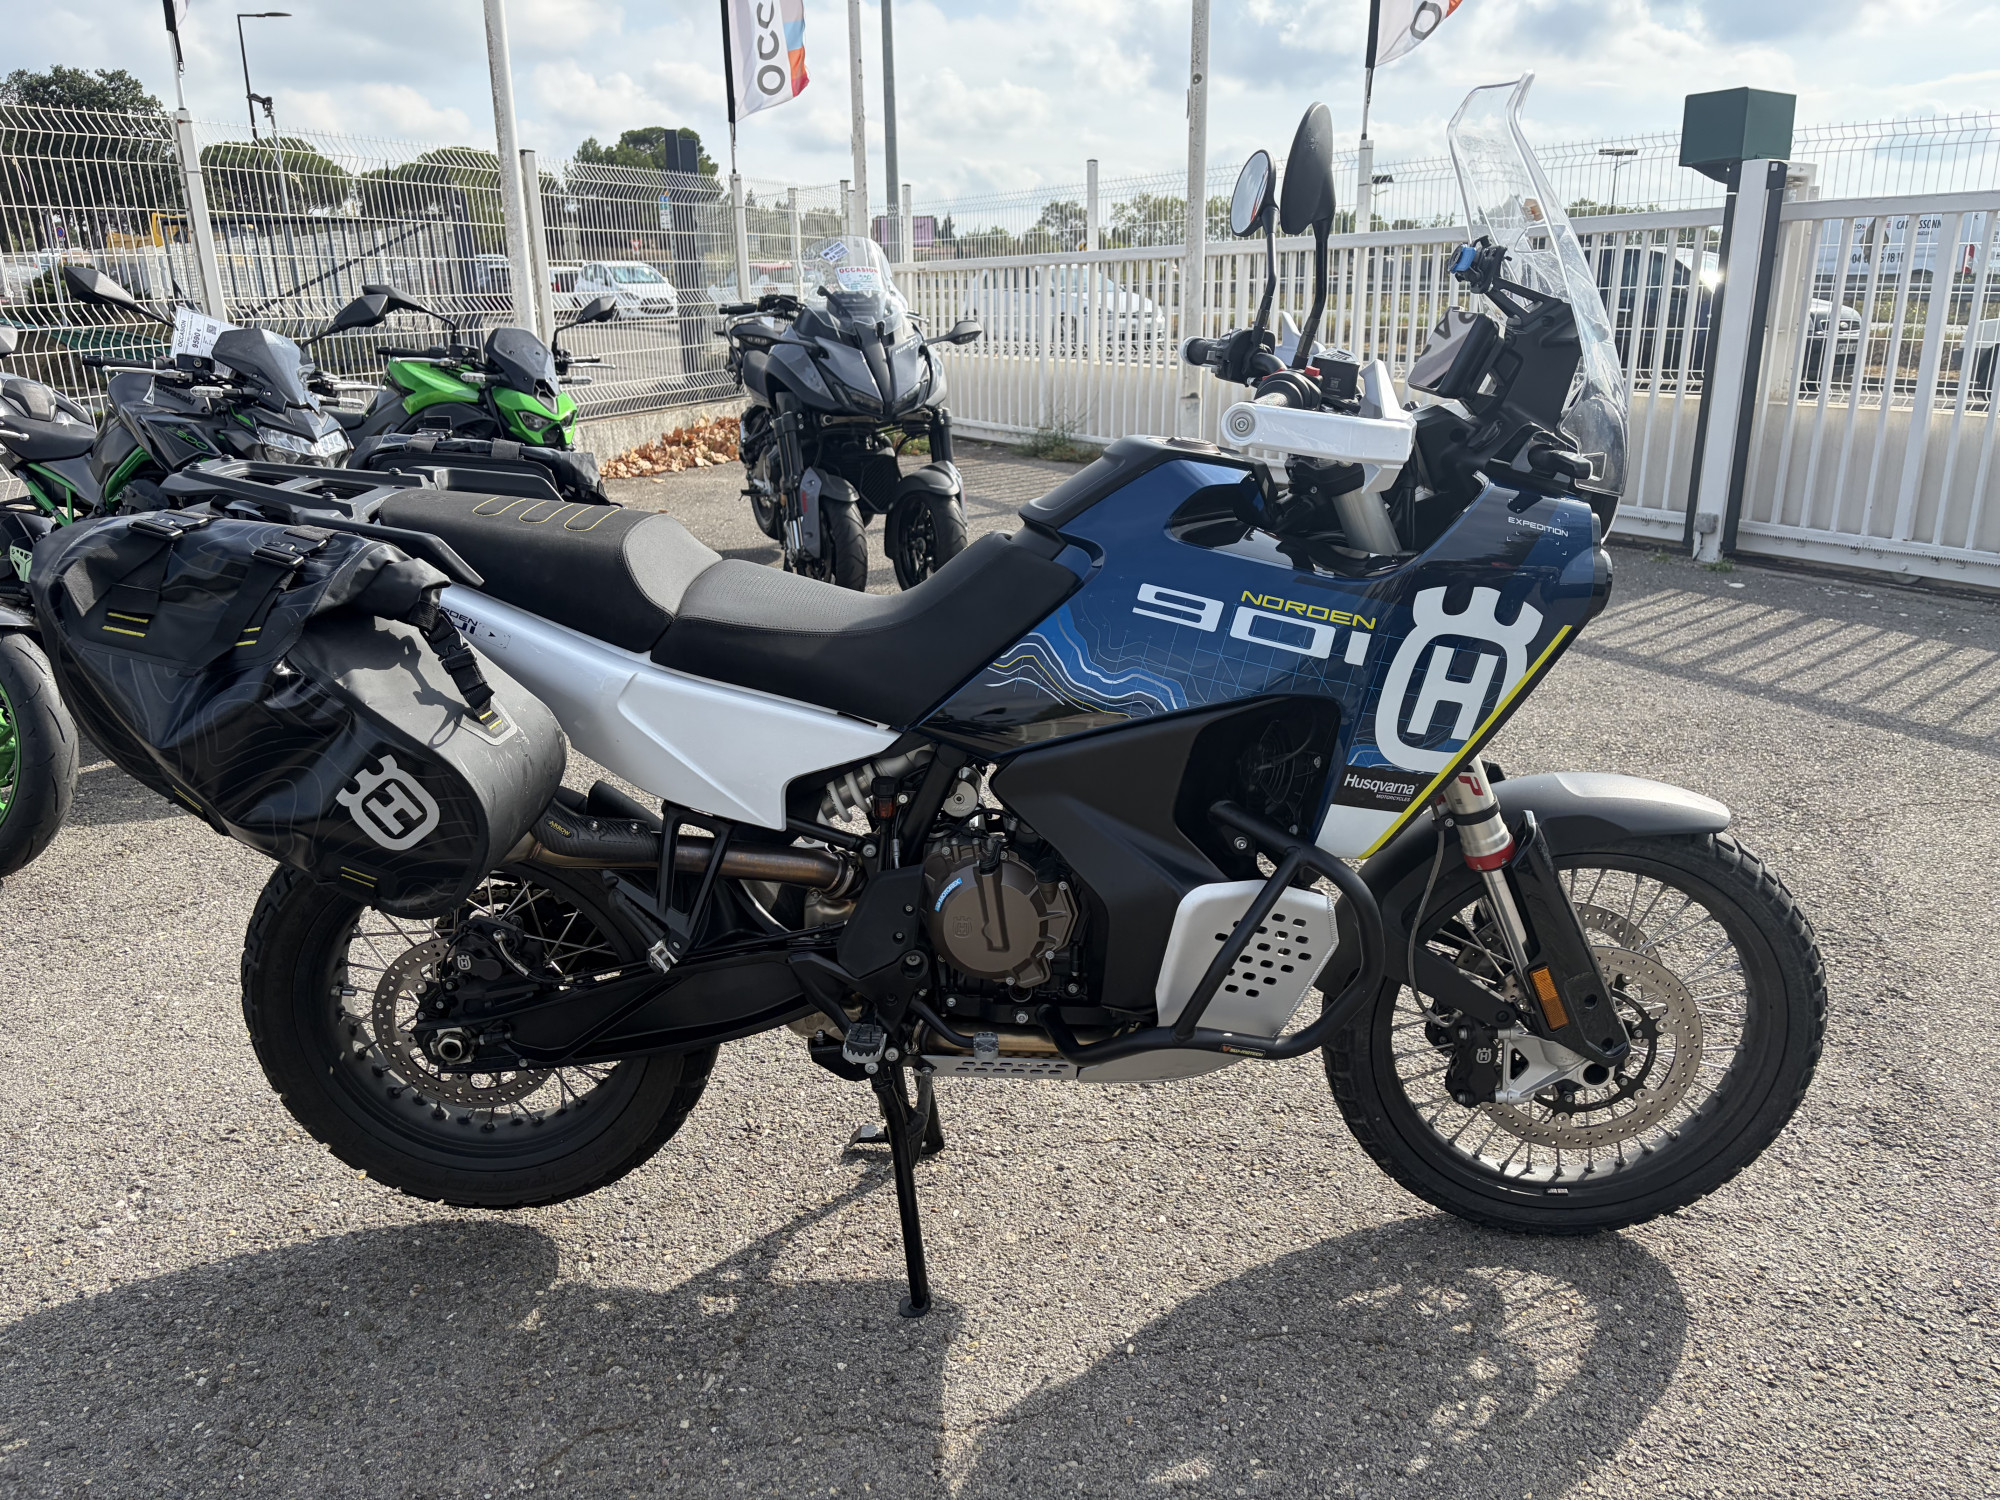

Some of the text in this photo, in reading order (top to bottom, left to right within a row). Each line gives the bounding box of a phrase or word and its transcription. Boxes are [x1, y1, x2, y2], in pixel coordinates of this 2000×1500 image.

[177, 319, 187, 348] OCCASION
[1508, 516, 1568, 538] EXPEDITION
[1241, 590, 1376, 630] NORDEN
[1132, 583, 1371, 667] 901
[1344, 773, 1416, 795] Husqvarna
[1375, 793, 1411, 803] MOTORCYCLES
[549, 820, 570, 836] ARROW
[937, 878, 962, 903] MOTOREX
